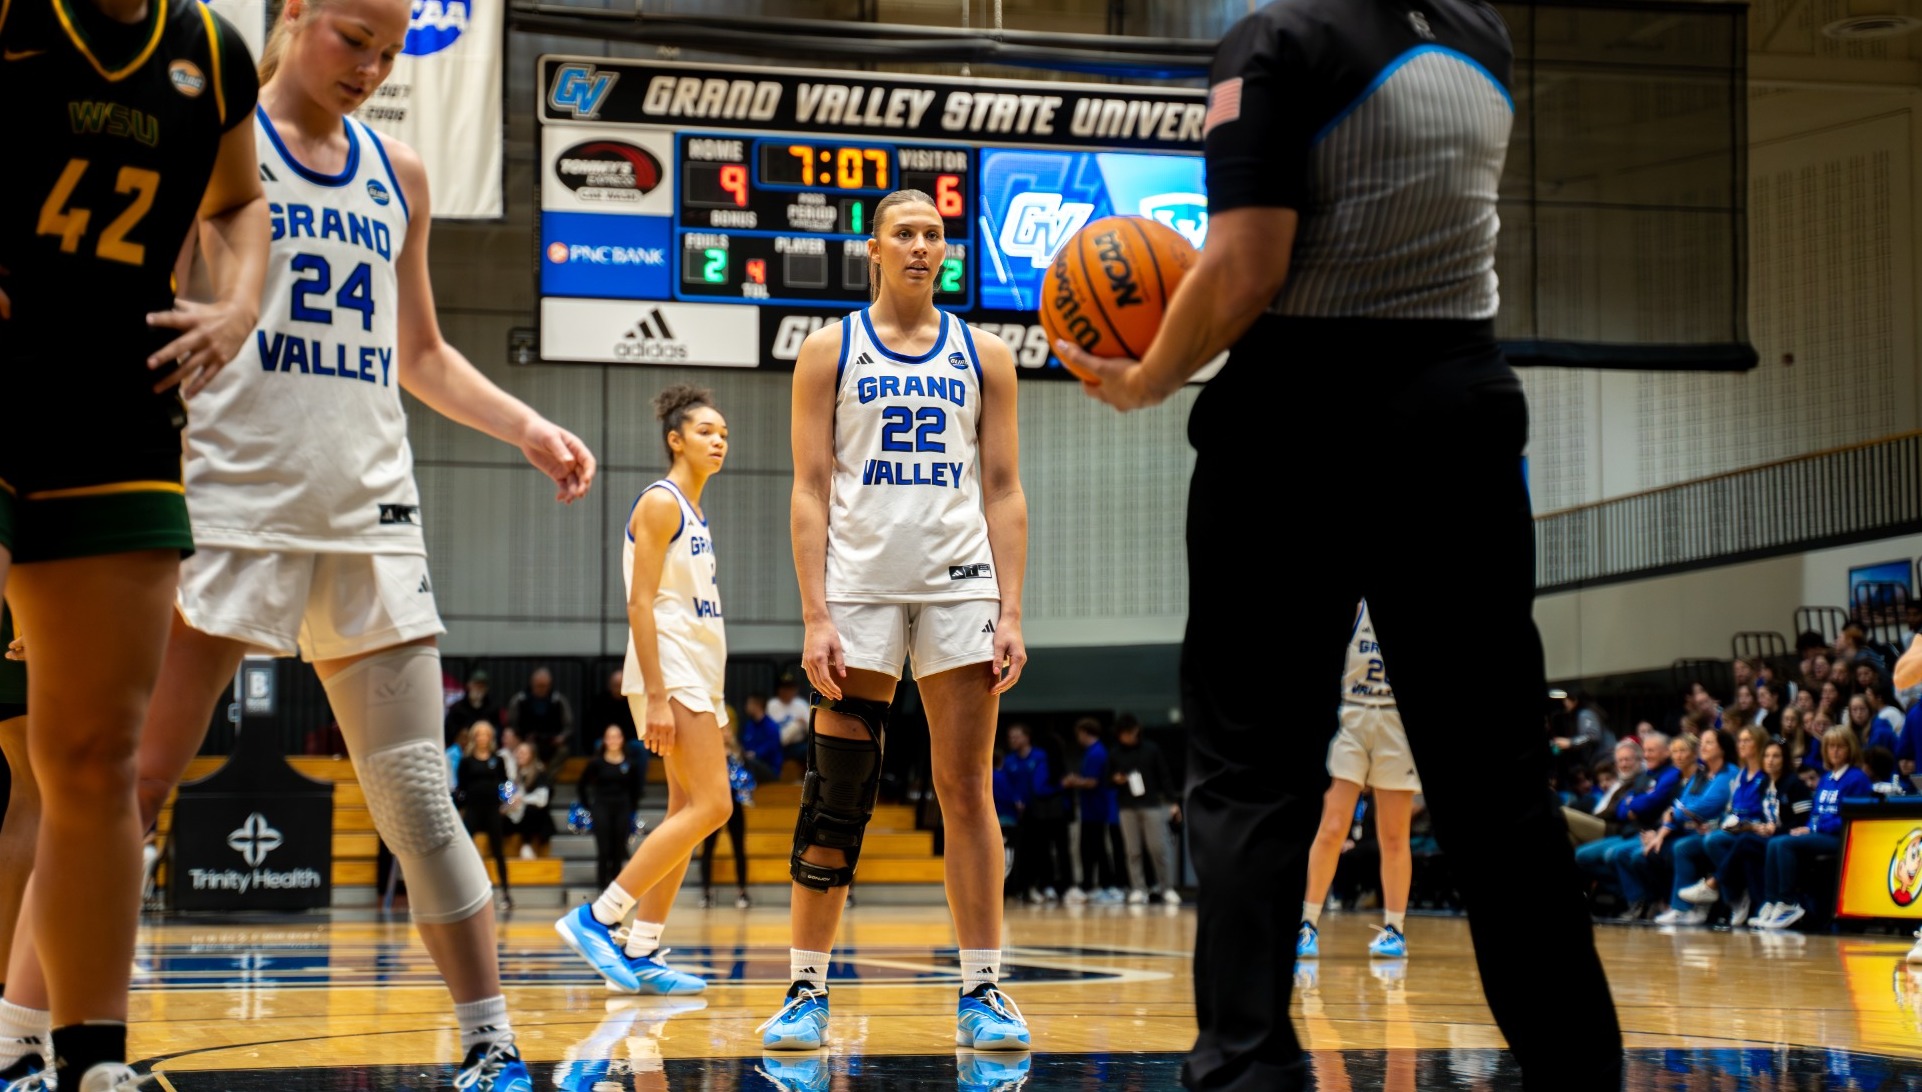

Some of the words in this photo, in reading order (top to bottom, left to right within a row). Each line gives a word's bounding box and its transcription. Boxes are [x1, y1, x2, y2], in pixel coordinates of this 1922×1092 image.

[642, 76, 783, 121] GRAND
[796, 83, 935, 129] VALLEY
[941, 91, 1063, 135] STATE
[68, 101, 160, 147] WSU
[688, 138, 744, 162] HOME
[899, 149, 968, 173] VISITOR
[788, 145, 888, 189] 7:07
[720, 165, 747, 207] 9
[936, 174, 963, 217] 6
[36, 157, 160, 266] 42
[710, 210, 757, 228] BONUS
[787, 204, 837, 221] PERIOD
[852, 201, 863, 234] 1
[269, 203, 391, 262] GRAND
[685, 232, 729, 250] FOULS
[774, 237, 826, 255] PLAYER
[570, 244, 612, 265] PNC
[612, 246, 665, 267] BANK
[704, 248, 727, 283] 2
[747, 259, 764, 285] 4
[1094, 230, 1143, 309] NCAA
[941, 258, 963, 291] 2
[290, 253, 375, 332] 24
[257, 329, 392, 387] VALLEY
[613, 338, 687, 361] adidas
[858, 376, 965, 407] GRAND
[881, 405, 946, 453] 22
[862, 459, 963, 489] VALLEY
[1366, 659, 1390, 684] 2
[189, 869, 251, 895] Trinity
[252, 867, 321, 889] Health
